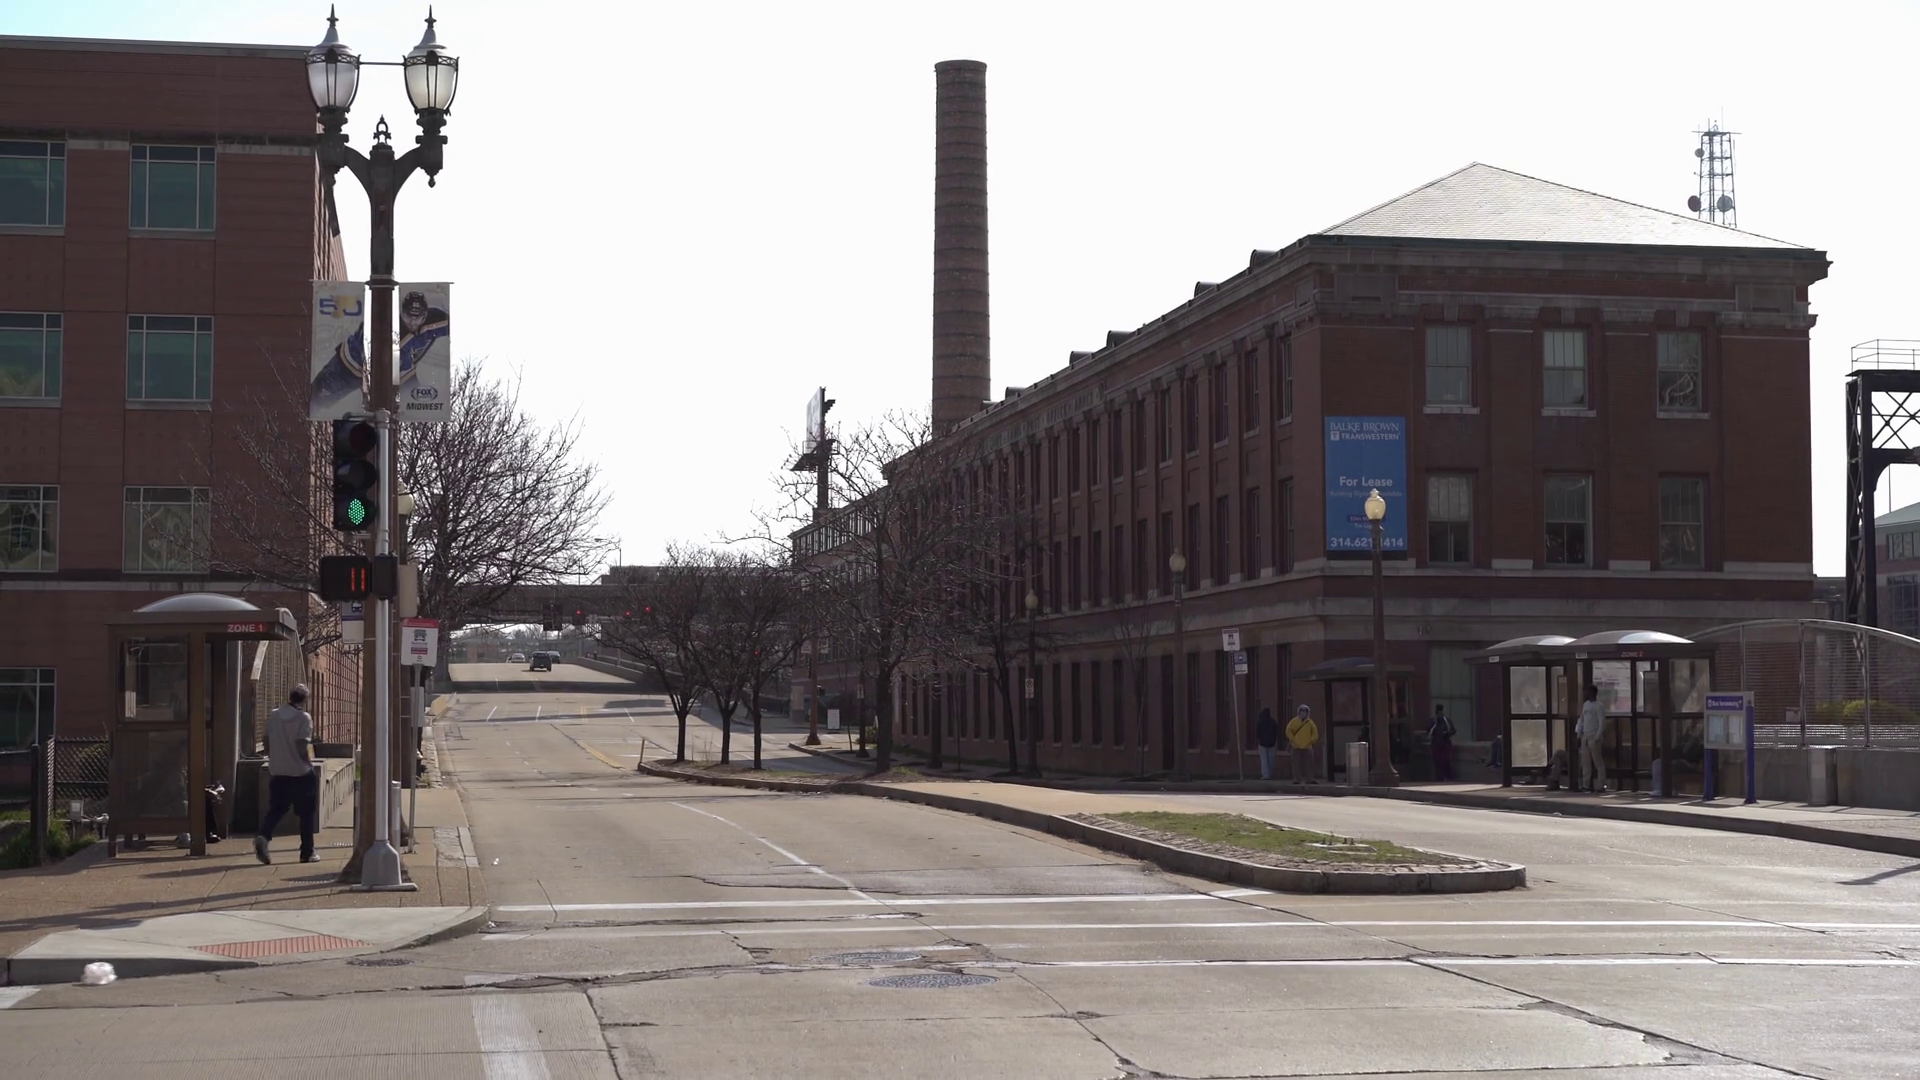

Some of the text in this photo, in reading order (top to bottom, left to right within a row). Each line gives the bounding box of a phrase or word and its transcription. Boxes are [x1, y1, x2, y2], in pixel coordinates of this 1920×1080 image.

[416, 388, 432, 397] FOX
[406, 402, 443, 411] MIDWEST
[1330, 422, 1399, 433] BALKE BROWN
[1339, 476, 1393, 487] For Lease
[351, 567, 367, 592] 11
[227, 624, 264, 633] ZONE 1
